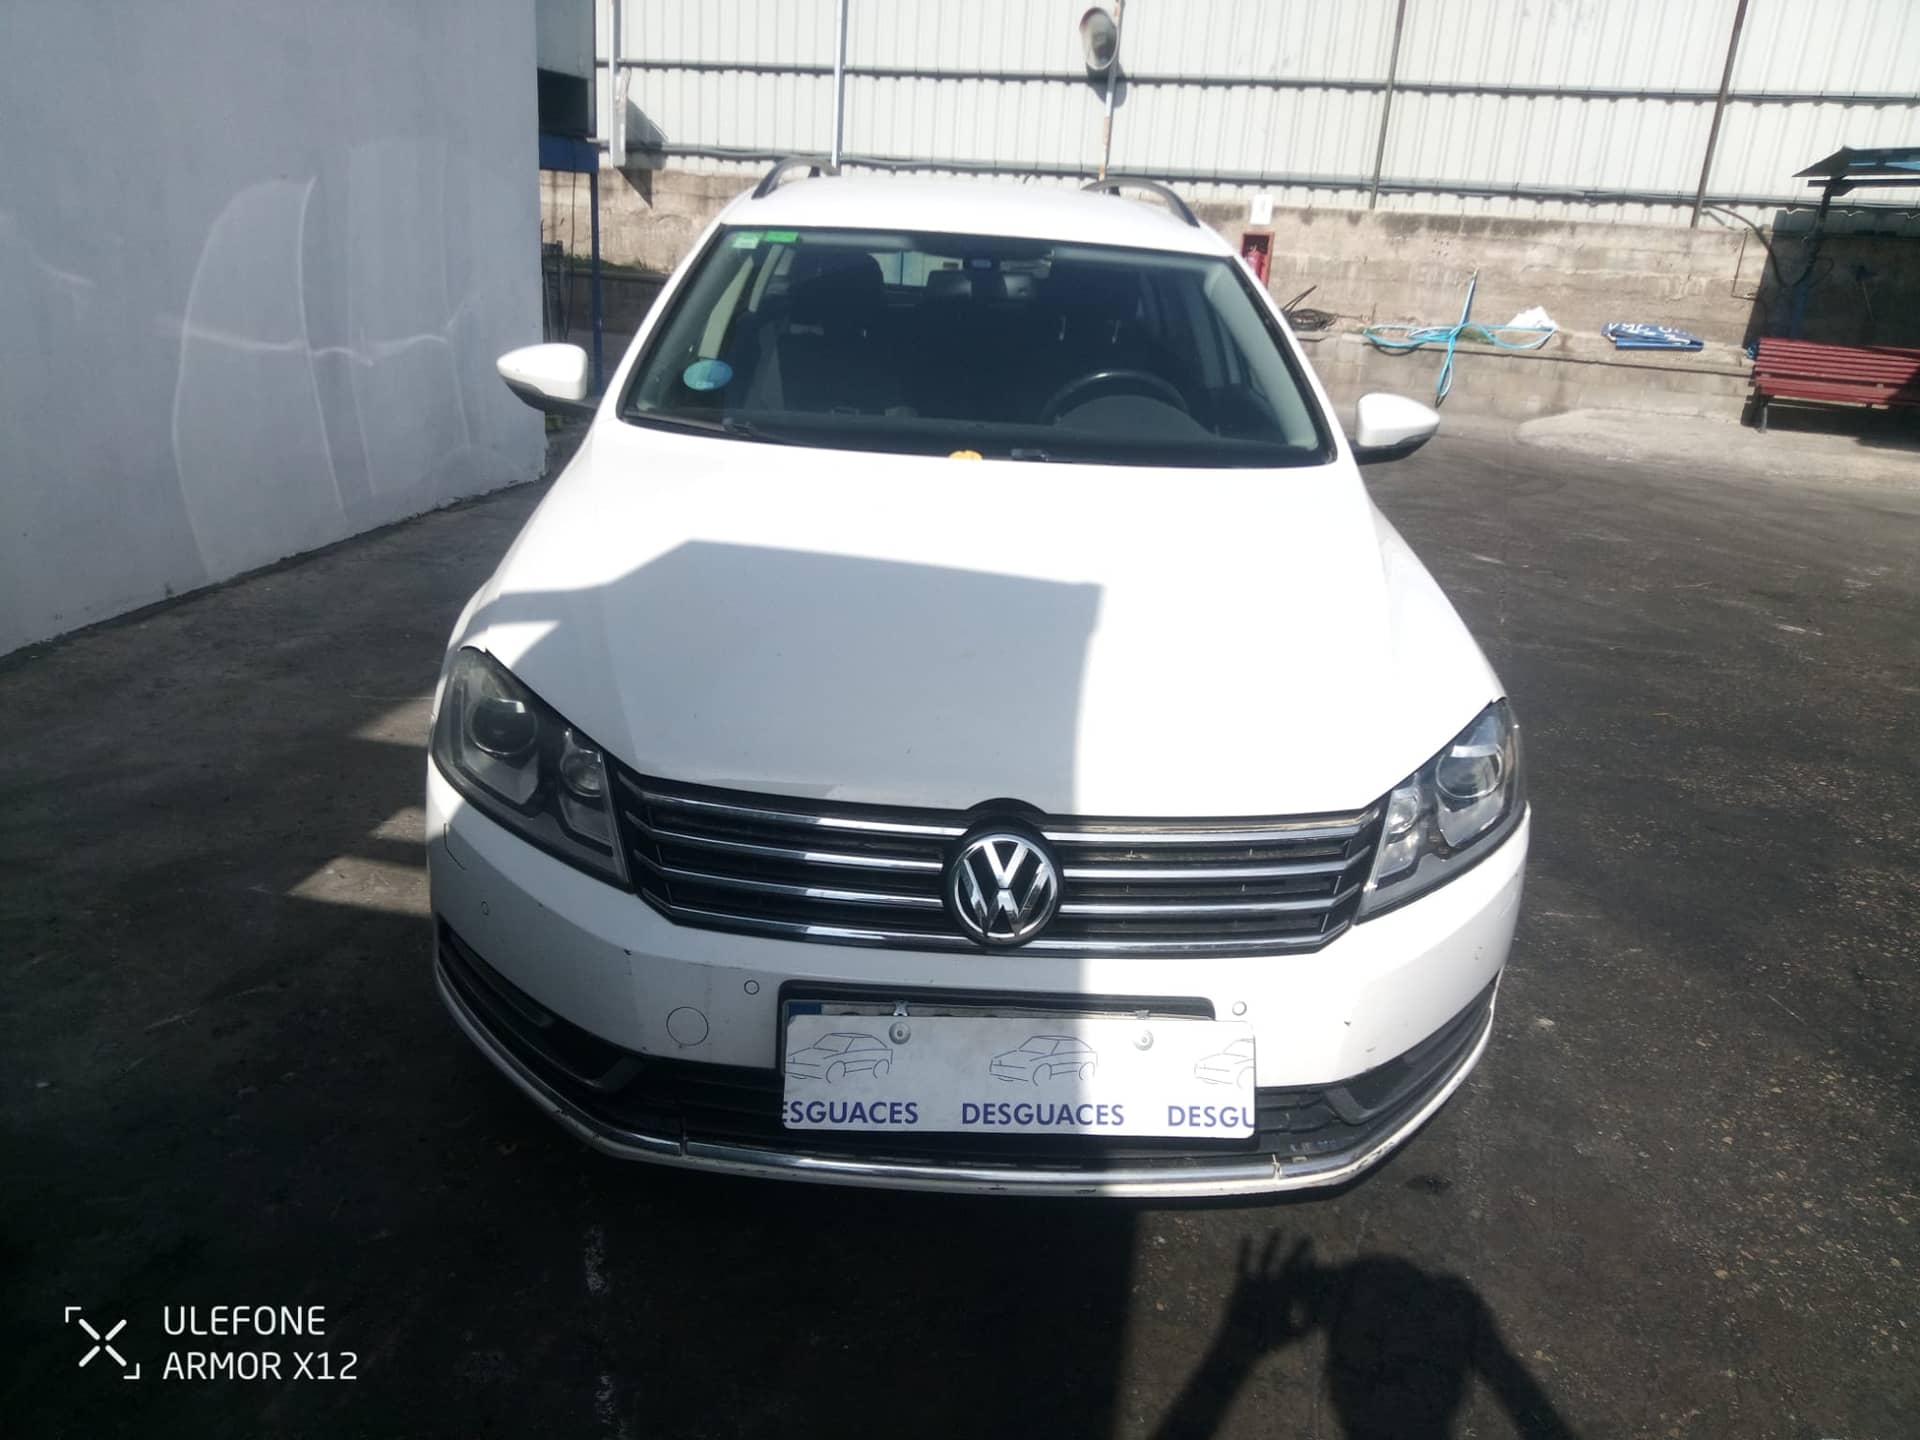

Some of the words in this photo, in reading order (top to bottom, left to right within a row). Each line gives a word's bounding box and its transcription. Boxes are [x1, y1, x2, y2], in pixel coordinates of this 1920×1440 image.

[955, 834, 1057, 940] VW
[962, 1102, 1124, 1126] DESGUACES
[1168, 1105, 1255, 1128] DESGU
